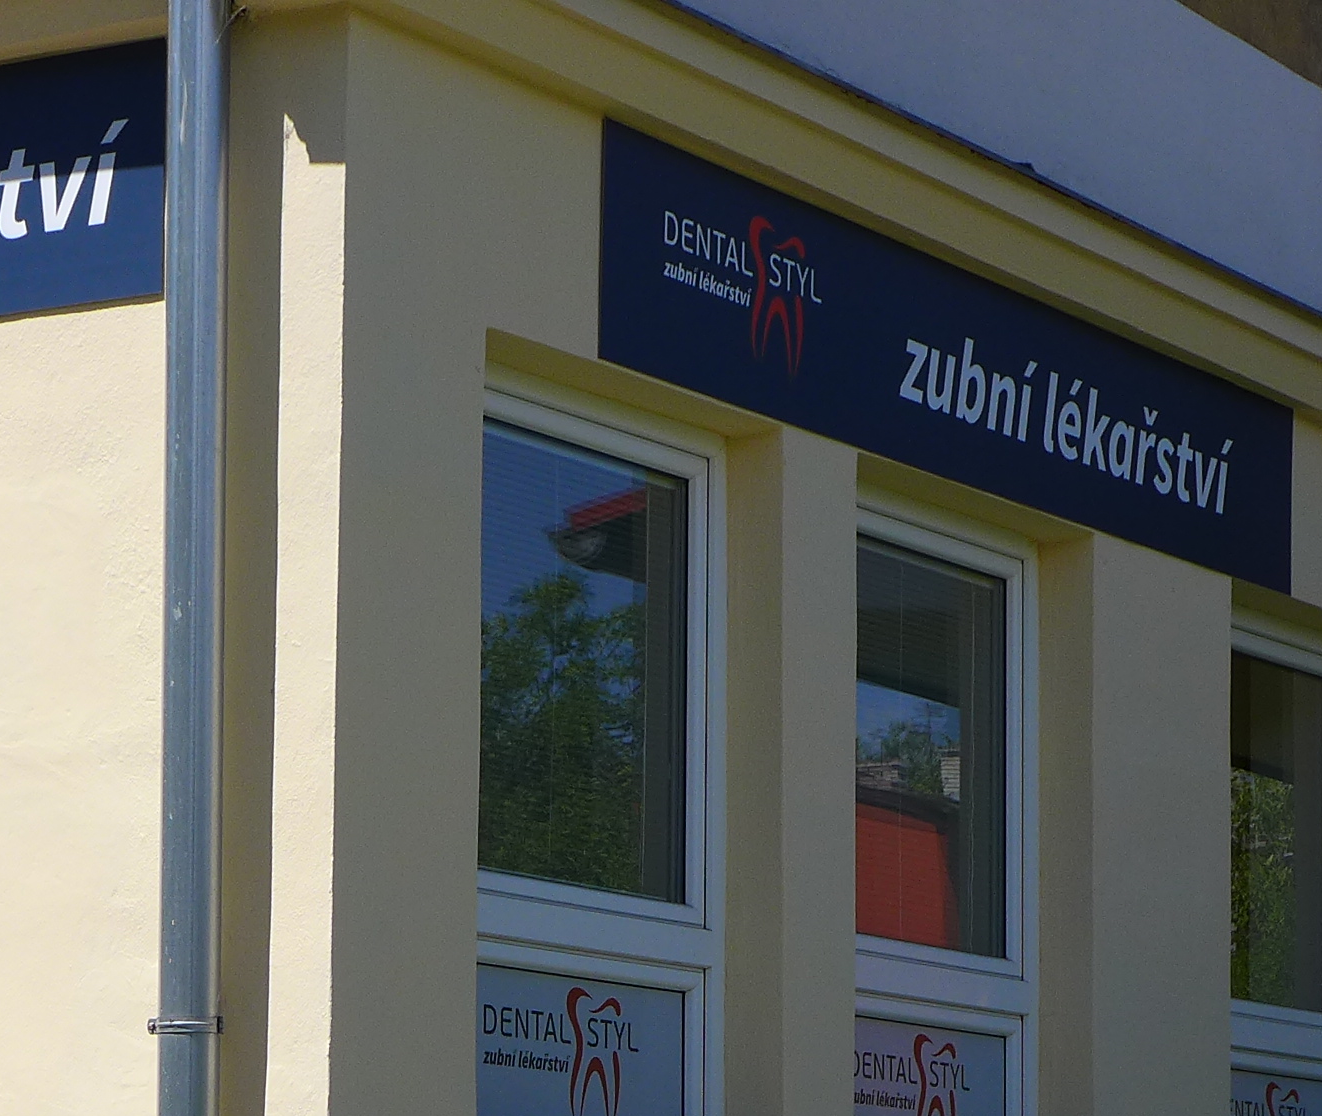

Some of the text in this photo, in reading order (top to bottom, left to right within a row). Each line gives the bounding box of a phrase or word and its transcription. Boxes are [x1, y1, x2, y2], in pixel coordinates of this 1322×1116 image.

[664, 210, 822, 304] DENTAL STYL
[663, 261, 753, 307] zubní lékařství
[899, 337, 1233, 515] zubní lékařství
[483, 1003, 639, 1053] DENTAL STYL
[483, 1047, 570, 1073] zubní lékařství
[929, 1060, 970, 1092] STYL
[854, 1088, 875, 1106] ubní
